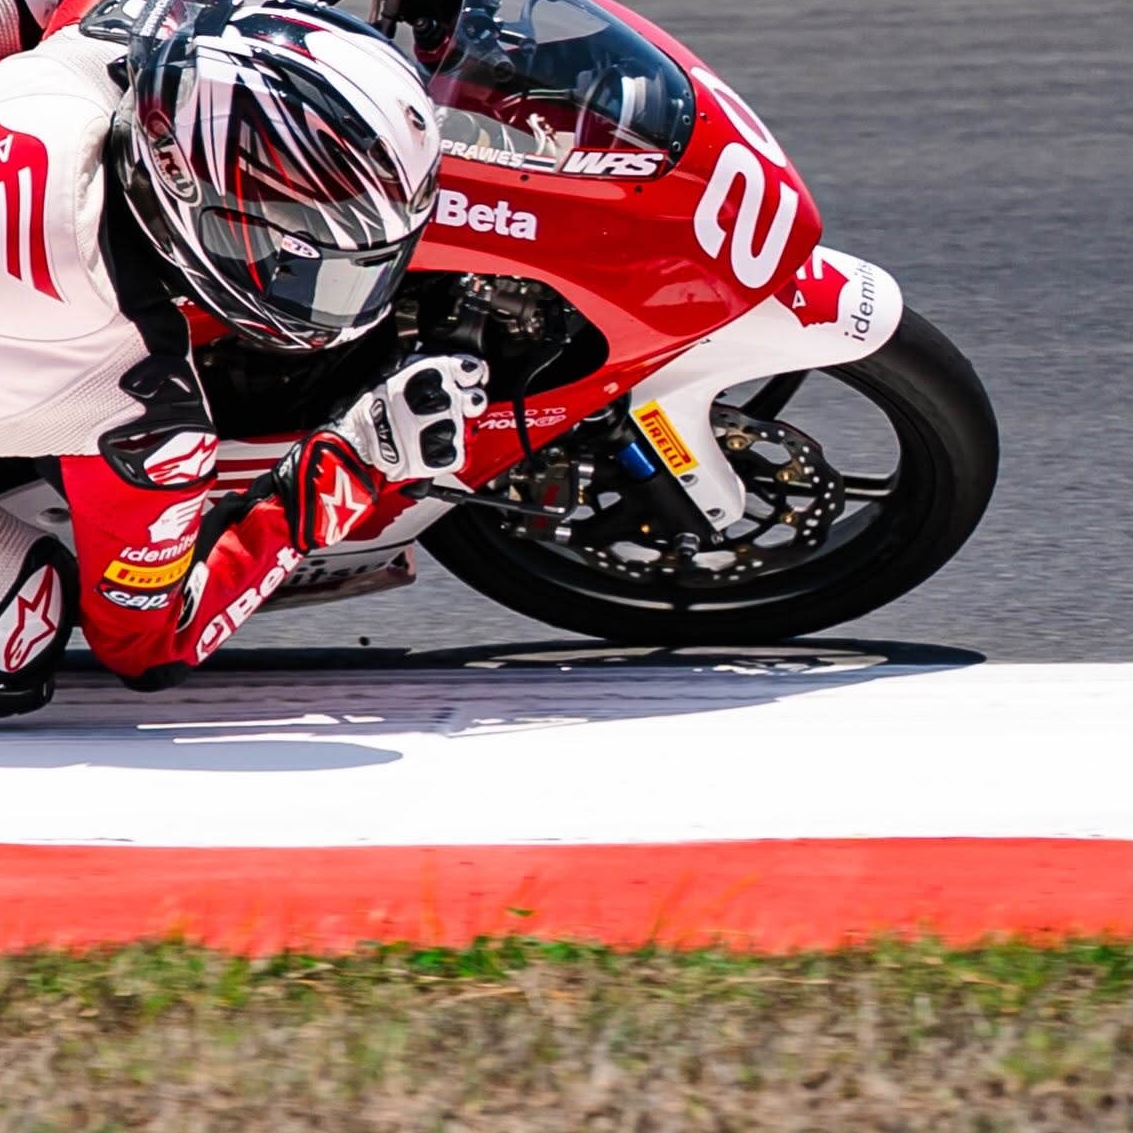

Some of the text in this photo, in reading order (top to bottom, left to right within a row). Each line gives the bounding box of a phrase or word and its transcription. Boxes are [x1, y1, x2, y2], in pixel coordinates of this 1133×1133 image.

[562, 151, 664, 177] WRS
[691, 67, 798, 288] 20
[436, 189, 537, 241] Beta
[640, 409, 692, 469] PIRELLI
[226, 545, 304, 628] Bet
